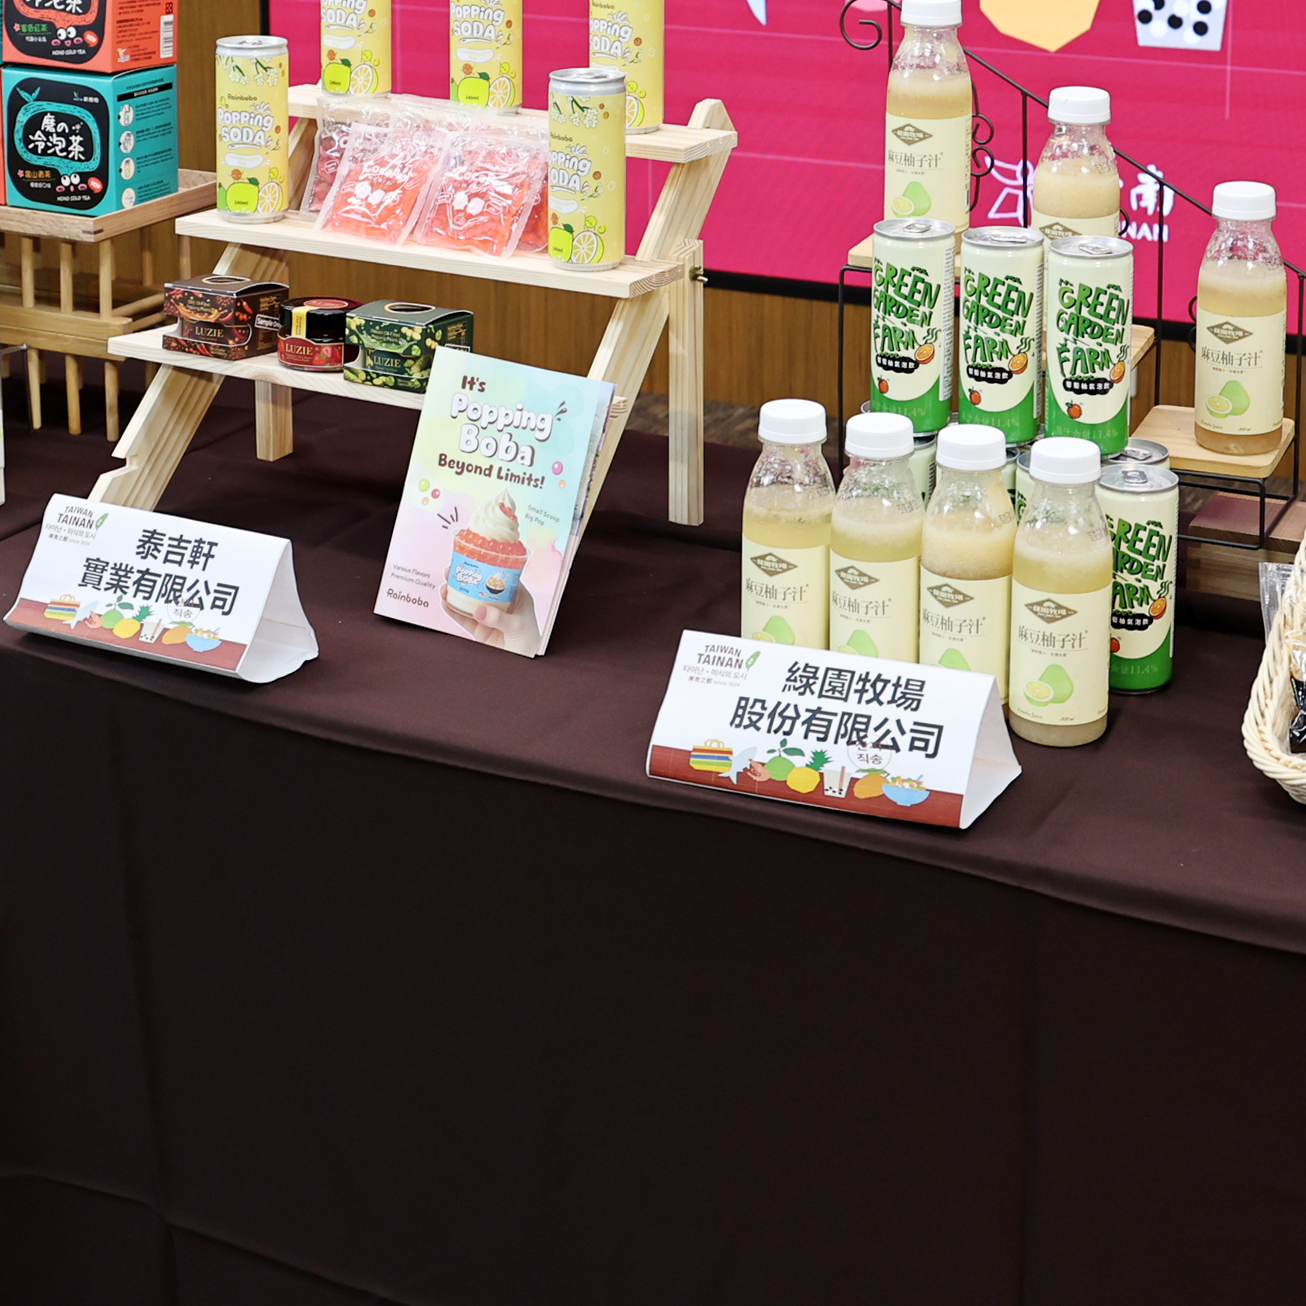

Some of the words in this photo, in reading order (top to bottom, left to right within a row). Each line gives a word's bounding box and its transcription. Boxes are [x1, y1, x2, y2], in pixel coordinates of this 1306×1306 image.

[453, 20, 497, 41] SODA
[27, 132, 86, 162] 冷泡茶
[221, 125, 266, 147] SODA
[872, 262, 942, 310] GREEN
[963, 271, 1034, 317] GREEN
[872, 289, 933, 328] GARDEN
[962, 299, 1027, 338] GARDEN
[1058, 285, 1130, 326] GREEN
[195, 326, 224, 338] LUZIE
[872, 321, 919, 353] FARM
[1055, 311, 1125, 345] GARDEN
[285, 343, 314, 355] LUZIE
[962, 331, 1013, 364] FARM
[1201, 345, 1262, 367] 麻豆柚子汁
[374, 355, 401, 368] LUZIE
[1056, 344, 1113, 378] FARM
[460, 375, 487, 394] It's
[449, 392, 554, 443] Popping
[458, 423, 536, 468] Boba
[437, 452, 494, 480] Beyond
[496, 465, 546, 490] Limits!
[57, 513, 94, 530] TAINAN
[64, 506, 94, 518] TAIWAN
[524, 512, 535, 524] Big
[535, 516, 546, 527] Pop
[527, 504, 543, 517] Small
[542, 508, 561, 524] Scoop
[135, 528, 219, 572] 泰吉軒
[390, 572, 415, 586] Premium
[414, 577, 437, 591] Quality
[392, 563, 410, 576] Various
[409, 567, 431, 580] Flavors
[77, 557, 240, 617] 實業有限公司
[386, 587, 430, 609] Rainboba
[745, 575, 807, 602] 麻豆柚子汁
[172, 607, 194, 620] 직송
[1017, 624, 1086, 650] 麻豆柚子汁
[696, 653, 743, 670] TAINAN
[704, 644, 741, 657] TAIWAN
[781, 660, 926, 712] 綠園牧場
[729, 695, 945, 759] 股份有限公司
[857, 752, 884, 765] 직송
